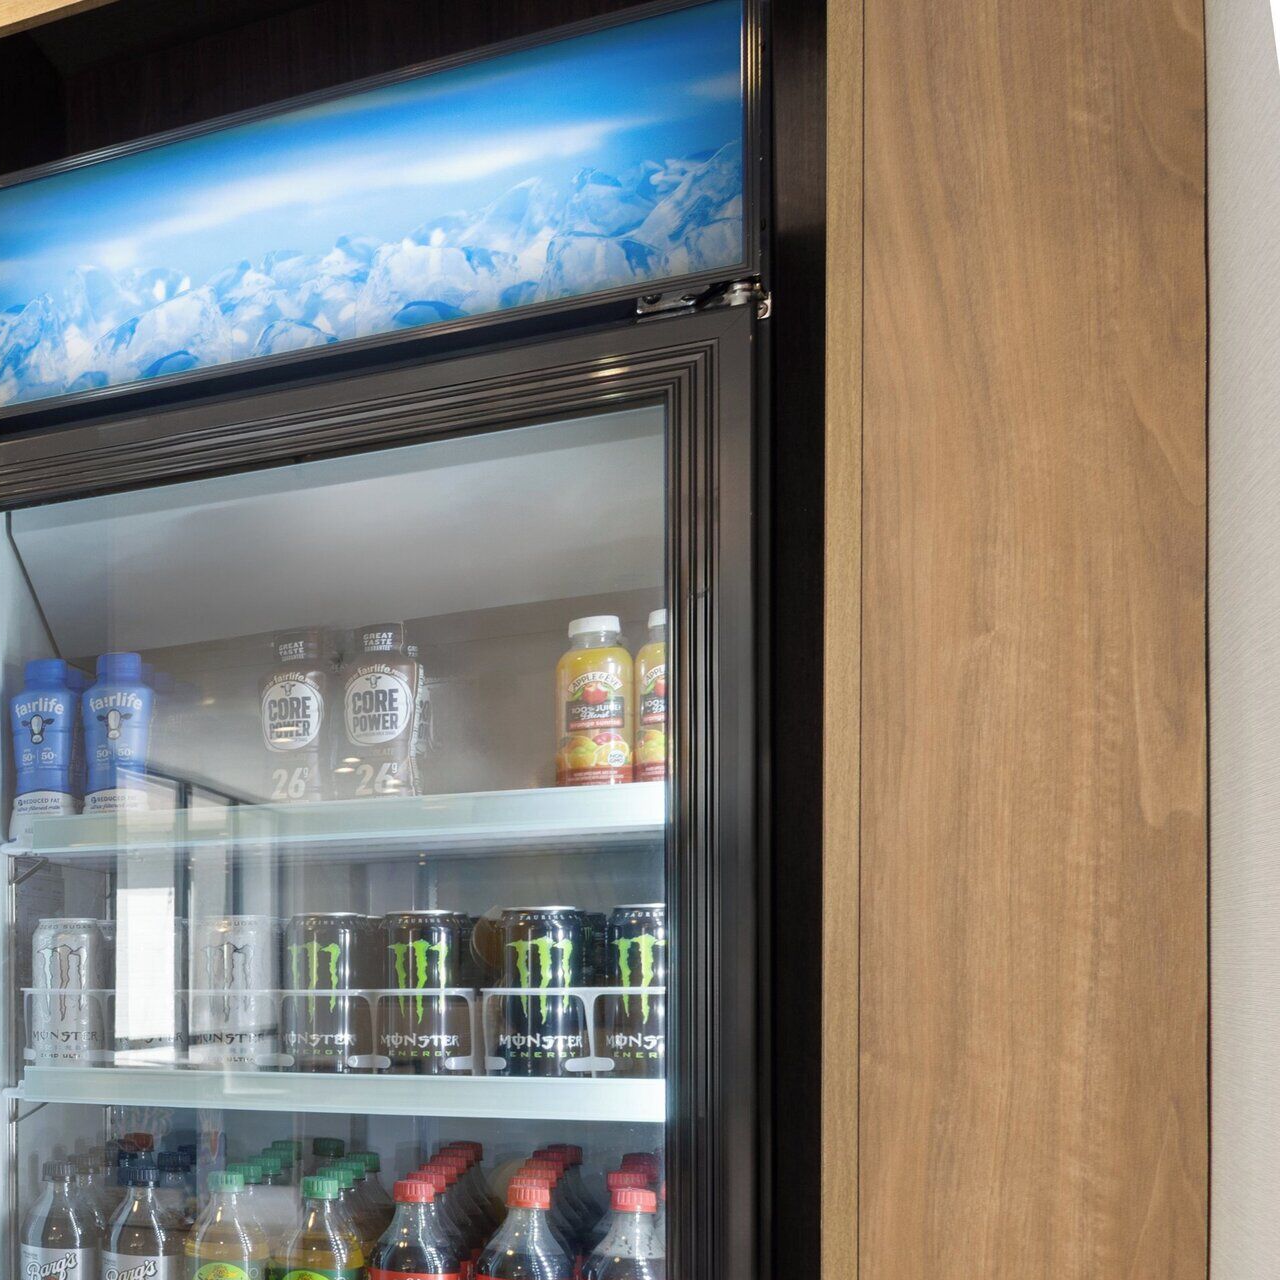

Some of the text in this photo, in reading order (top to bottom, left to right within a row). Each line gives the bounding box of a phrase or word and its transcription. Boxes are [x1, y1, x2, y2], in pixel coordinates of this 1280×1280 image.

[279, 641, 305, 651] GREAT
[572, 673, 597, 690] APPLE
[268, 696, 311, 721] CORE
[351, 689, 399, 715] CORE
[269, 720, 311, 739] POWER
[353, 713, 399, 734] POWER
[398, 917, 442, 925] TAURINE
[519, 913, 566, 921] TAURINE
[32, 1030, 98, 1043] MONSTER
[282, 1032, 356, 1048] MONSTER
[380, 1033, 461, 1048] MONSTER
[500, 1033, 583, 1049] MONSTER
[287, 1048, 345, 1056] ENERGY
[510, 1050, 578, 1059] ENERGY
